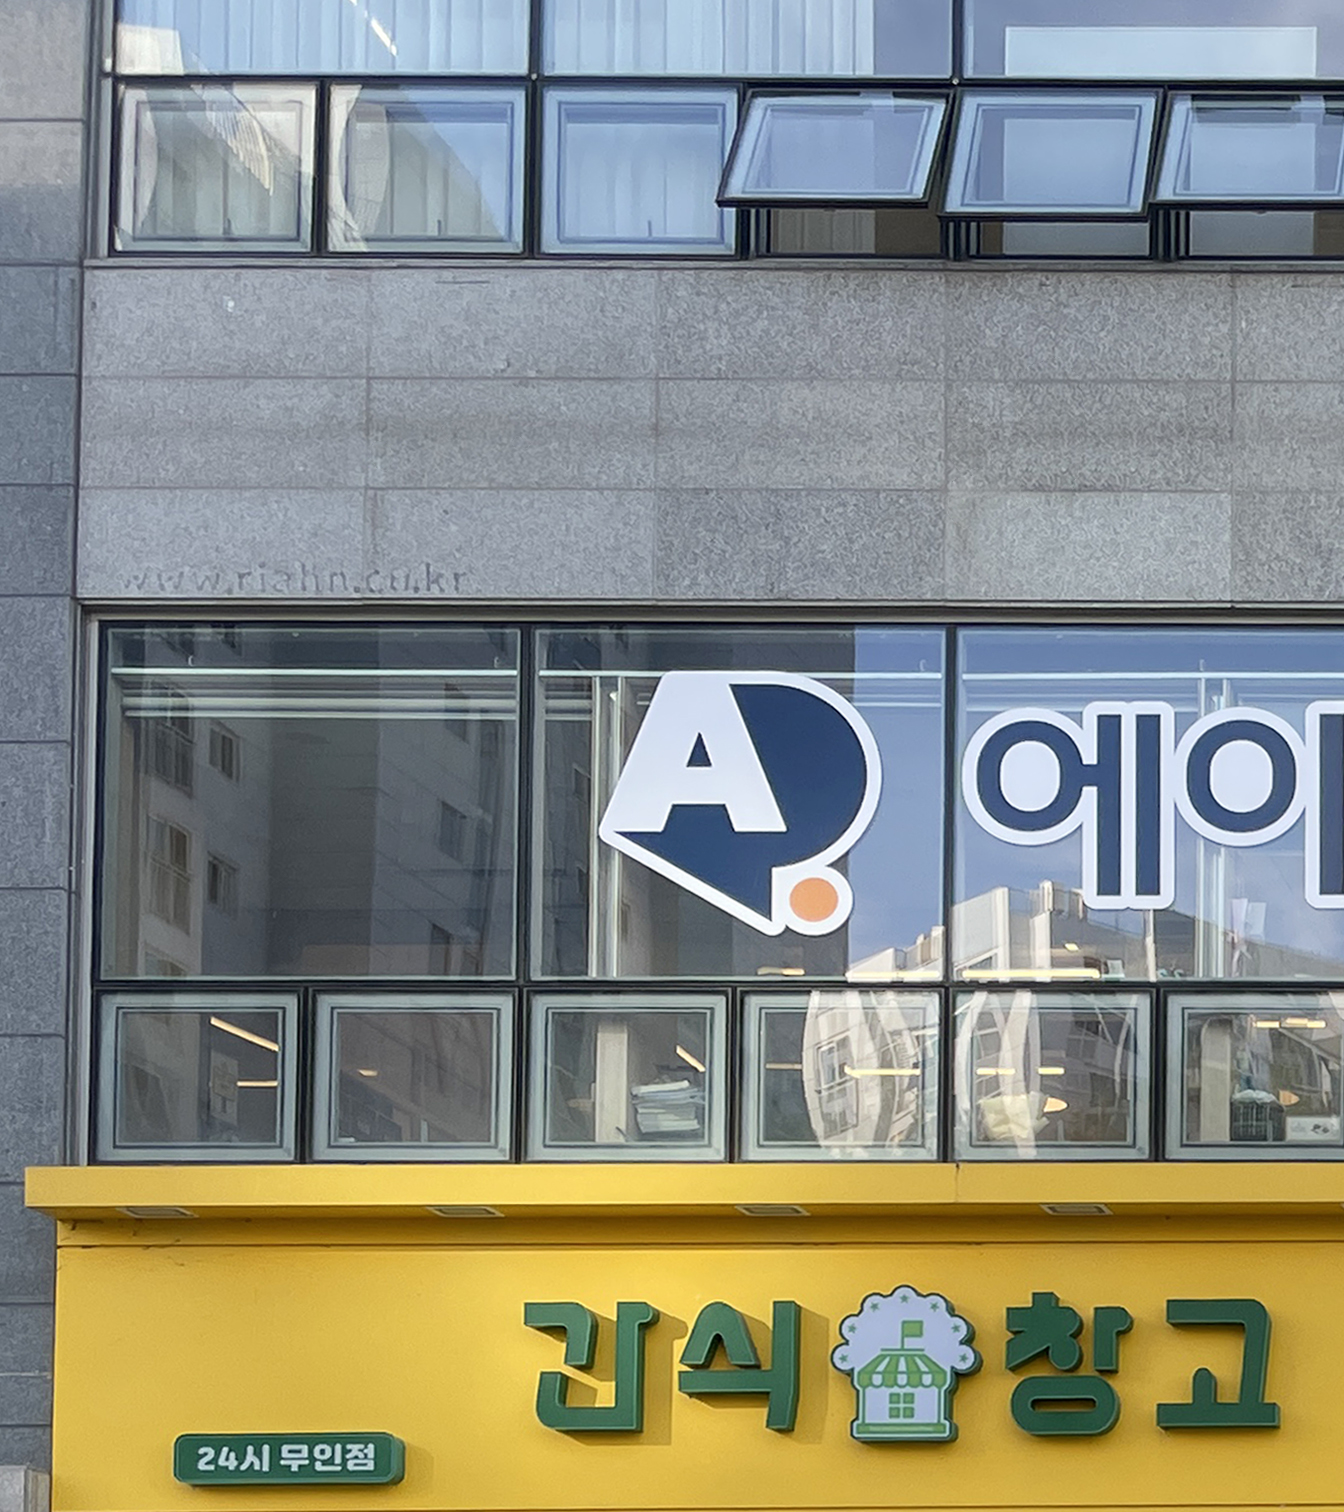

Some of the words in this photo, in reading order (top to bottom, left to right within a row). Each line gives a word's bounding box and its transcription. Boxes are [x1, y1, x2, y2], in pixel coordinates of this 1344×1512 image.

[523, 1300, 800, 1434] 간식
[1004, 1291, 1281, 1437] 창고
[196, 1443, 270, 1475] 24시
[279, 1442, 377, 1474] 무인점
